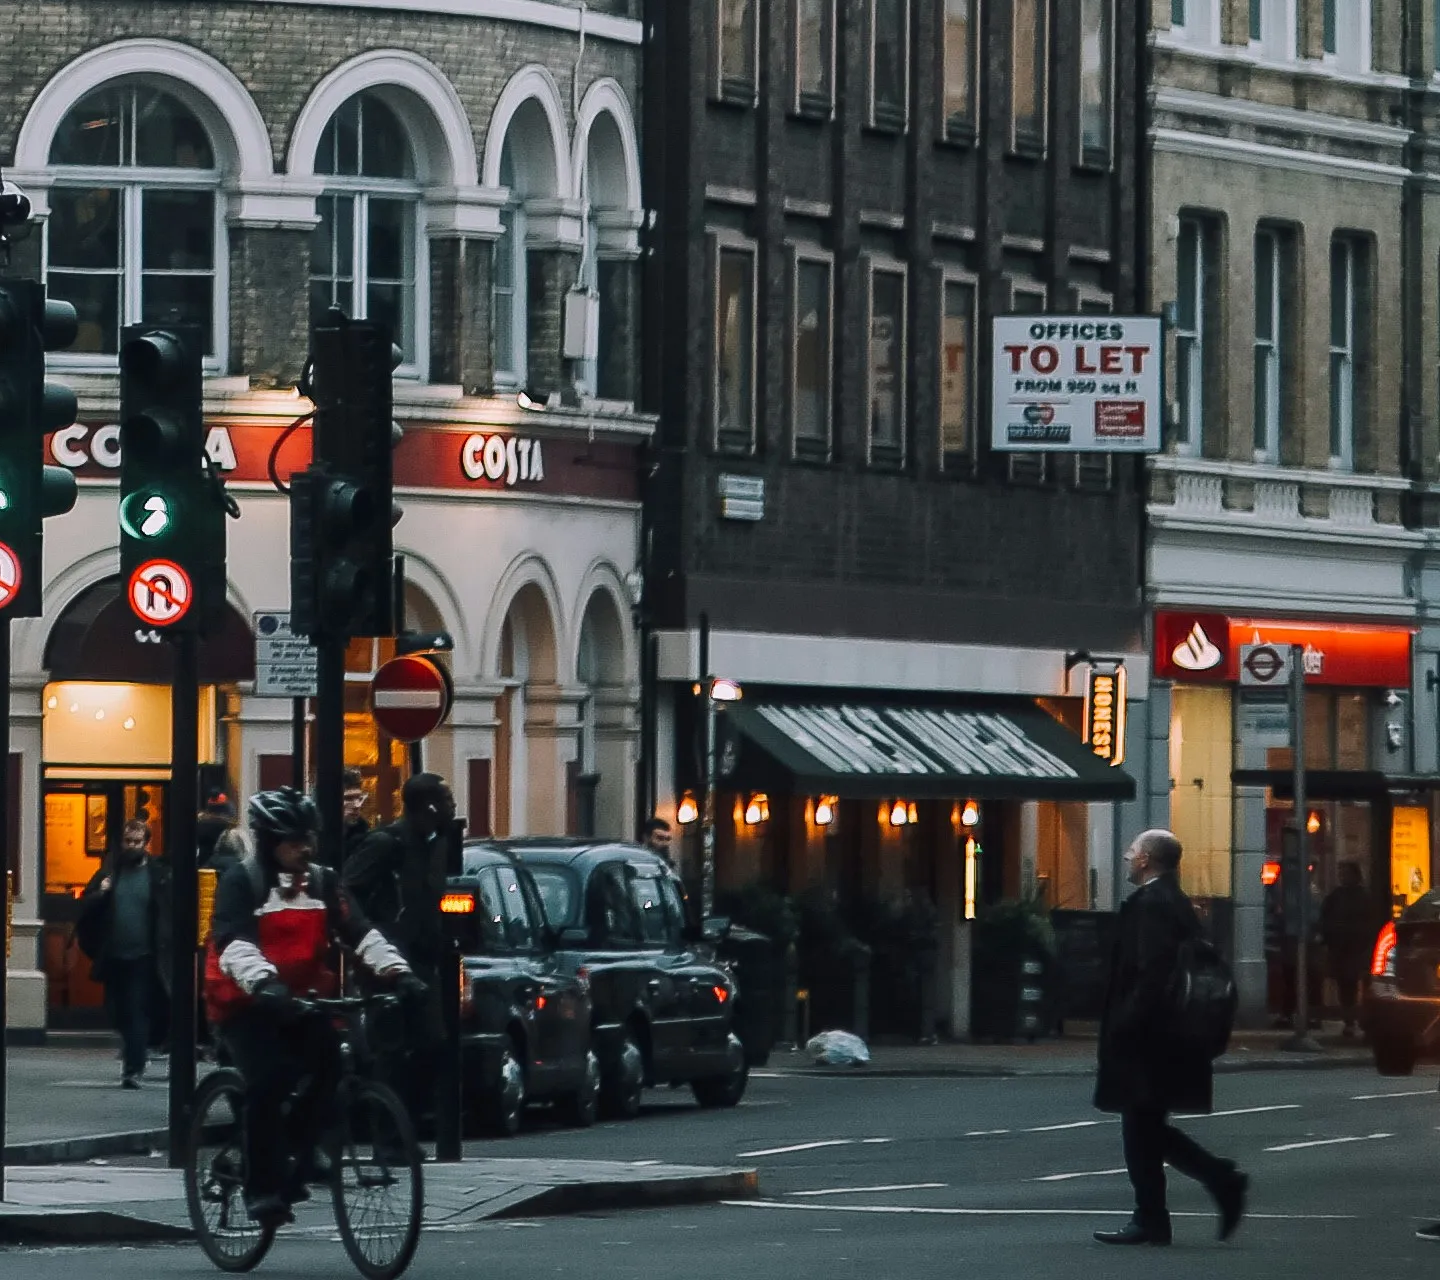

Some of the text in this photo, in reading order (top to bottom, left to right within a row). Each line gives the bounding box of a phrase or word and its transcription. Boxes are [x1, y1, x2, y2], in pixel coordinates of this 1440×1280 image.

[1030, 322, 1124, 341] OFFICES
[1004, 344, 1150, 375] TO LET
[1015, 378, 1062, 393] FROM
[51, 426, 237, 470] COA
[463, 434, 544, 485] COSTA
[1093, 675, 1114, 758] HONEST
